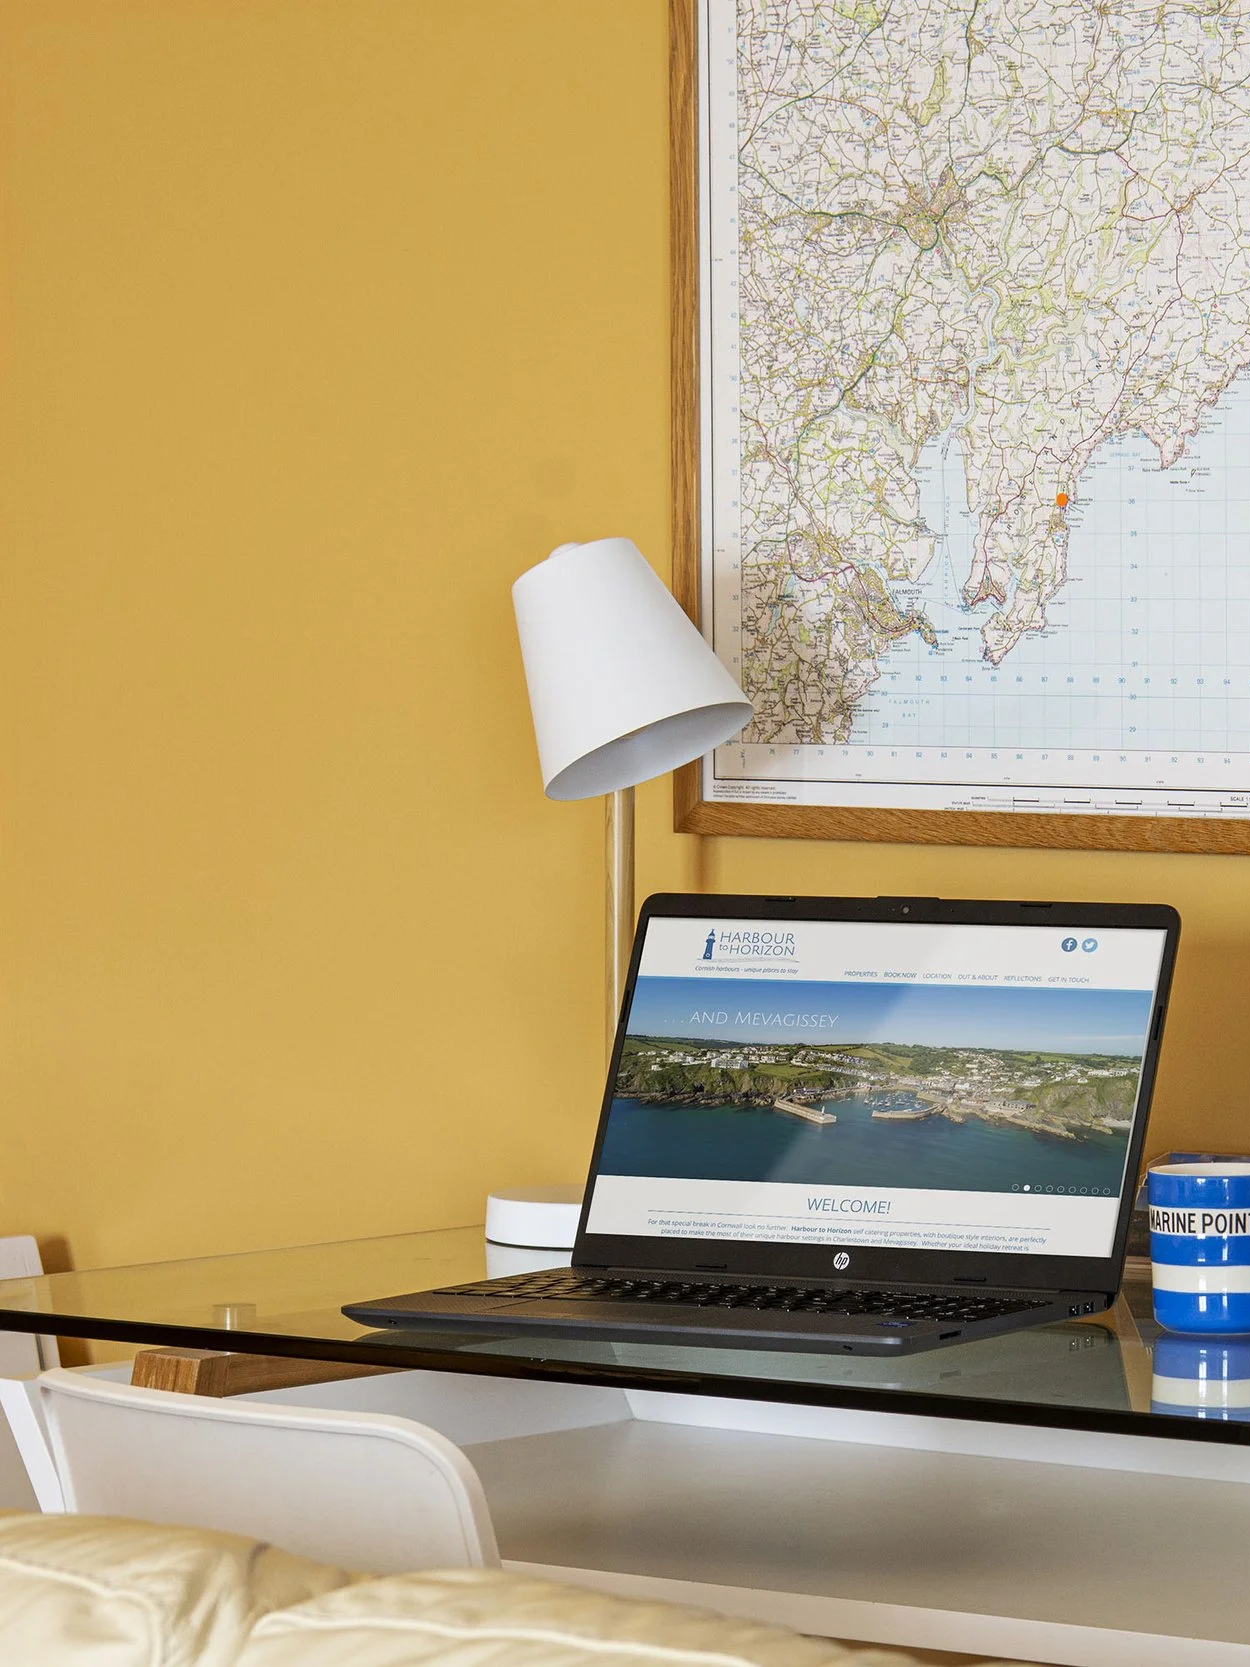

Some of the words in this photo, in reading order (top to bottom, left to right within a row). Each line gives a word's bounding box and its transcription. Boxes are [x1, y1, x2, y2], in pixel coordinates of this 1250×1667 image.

[720, 931, 795, 944] HARBOUR
[729, 945, 795, 956] HORIZON
[689, 1011, 728, 1025] AND
[734, 1011, 839, 1028] MEVAGISSEY
[807, 1198, 892, 1214] WELCOME!
[1150, 1211, 1196, 1234] MARINE
[864, 1229, 888, 1237] catering
[889, 1230, 922, 1238] properties,
[1020, 1236, 1047, 1244] perfectly
[979, 1243, 1000, 1251] holiday
[834, 1252, 848, 1270] hp
